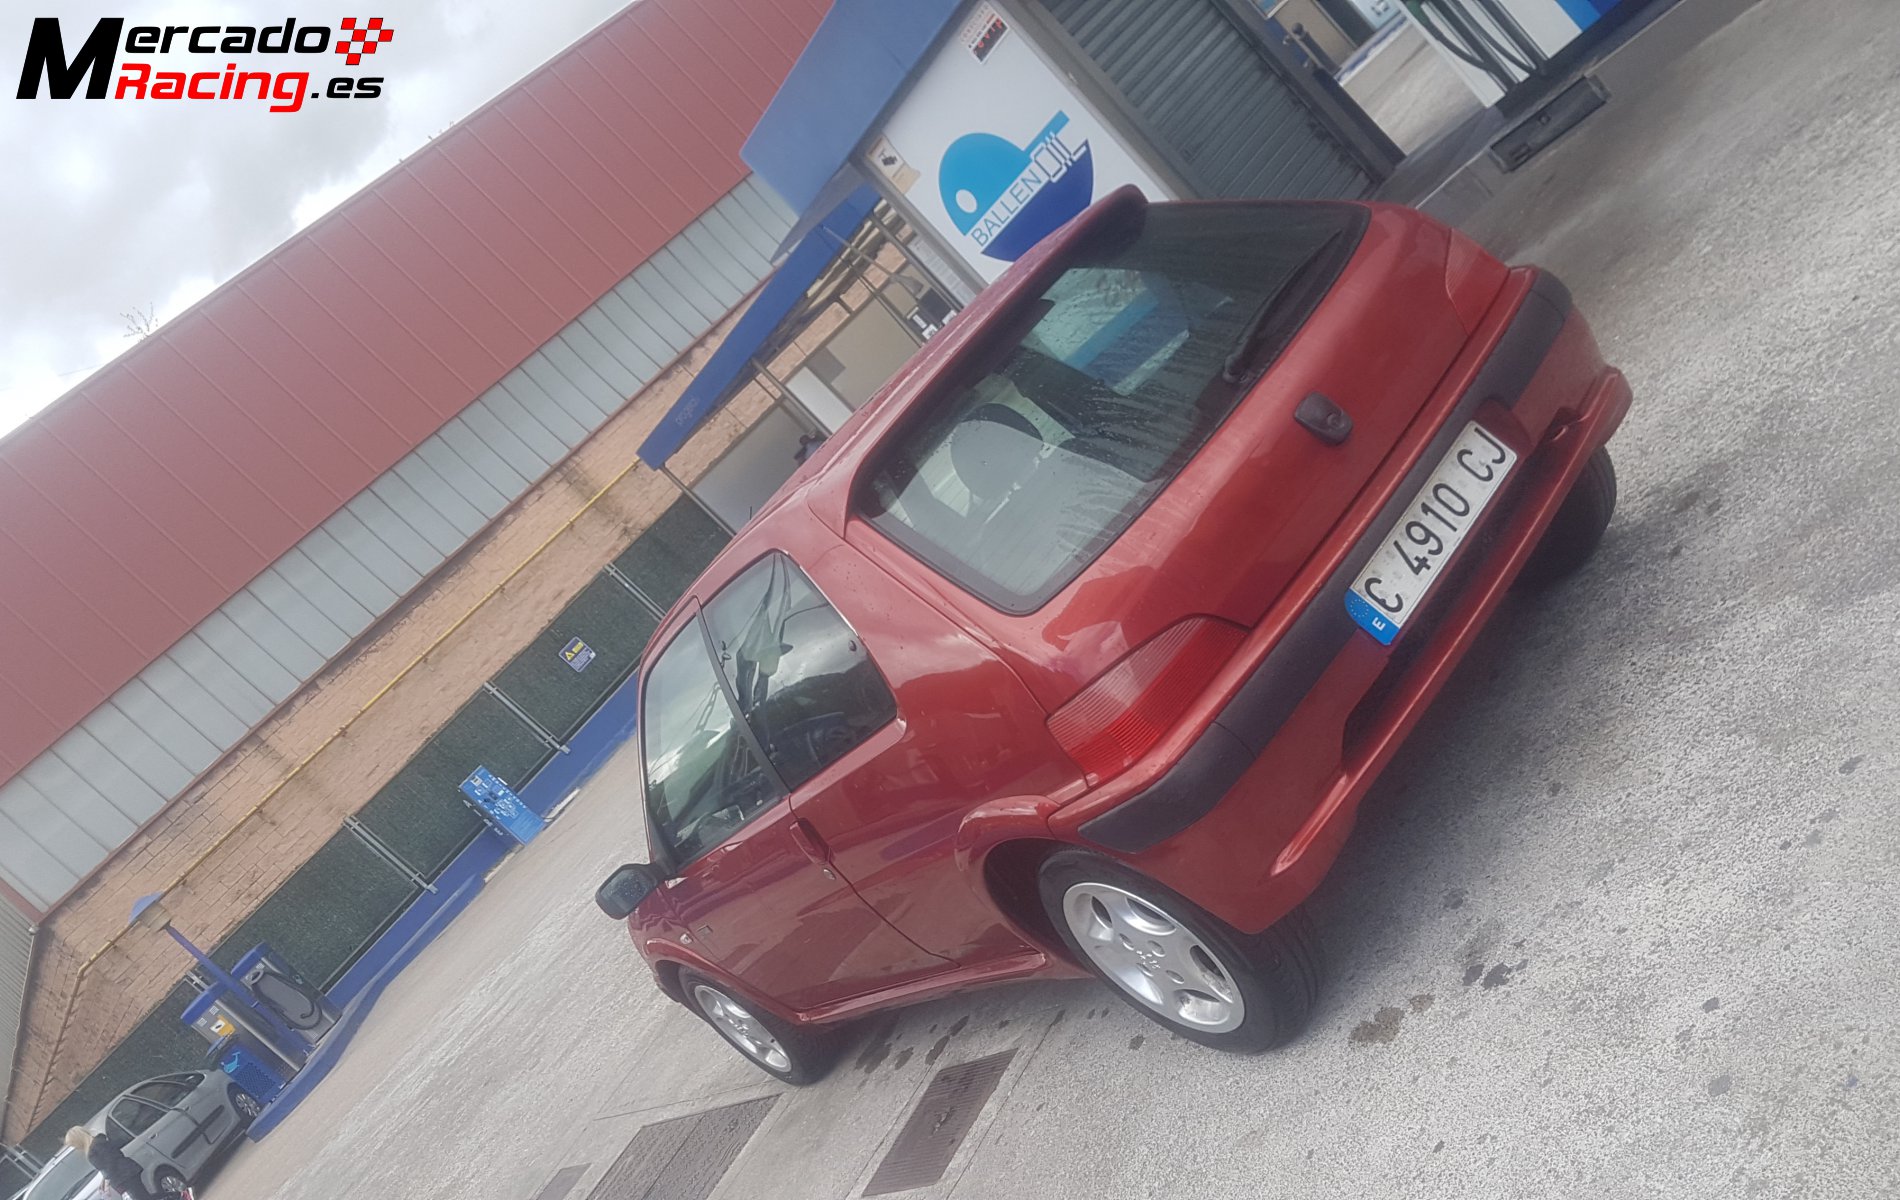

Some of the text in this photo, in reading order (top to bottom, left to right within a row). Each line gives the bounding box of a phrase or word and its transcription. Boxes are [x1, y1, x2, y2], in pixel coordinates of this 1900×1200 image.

[1364, 427, 1506, 613] C 4910 CJ
[1371, 616, 1386, 631] E
